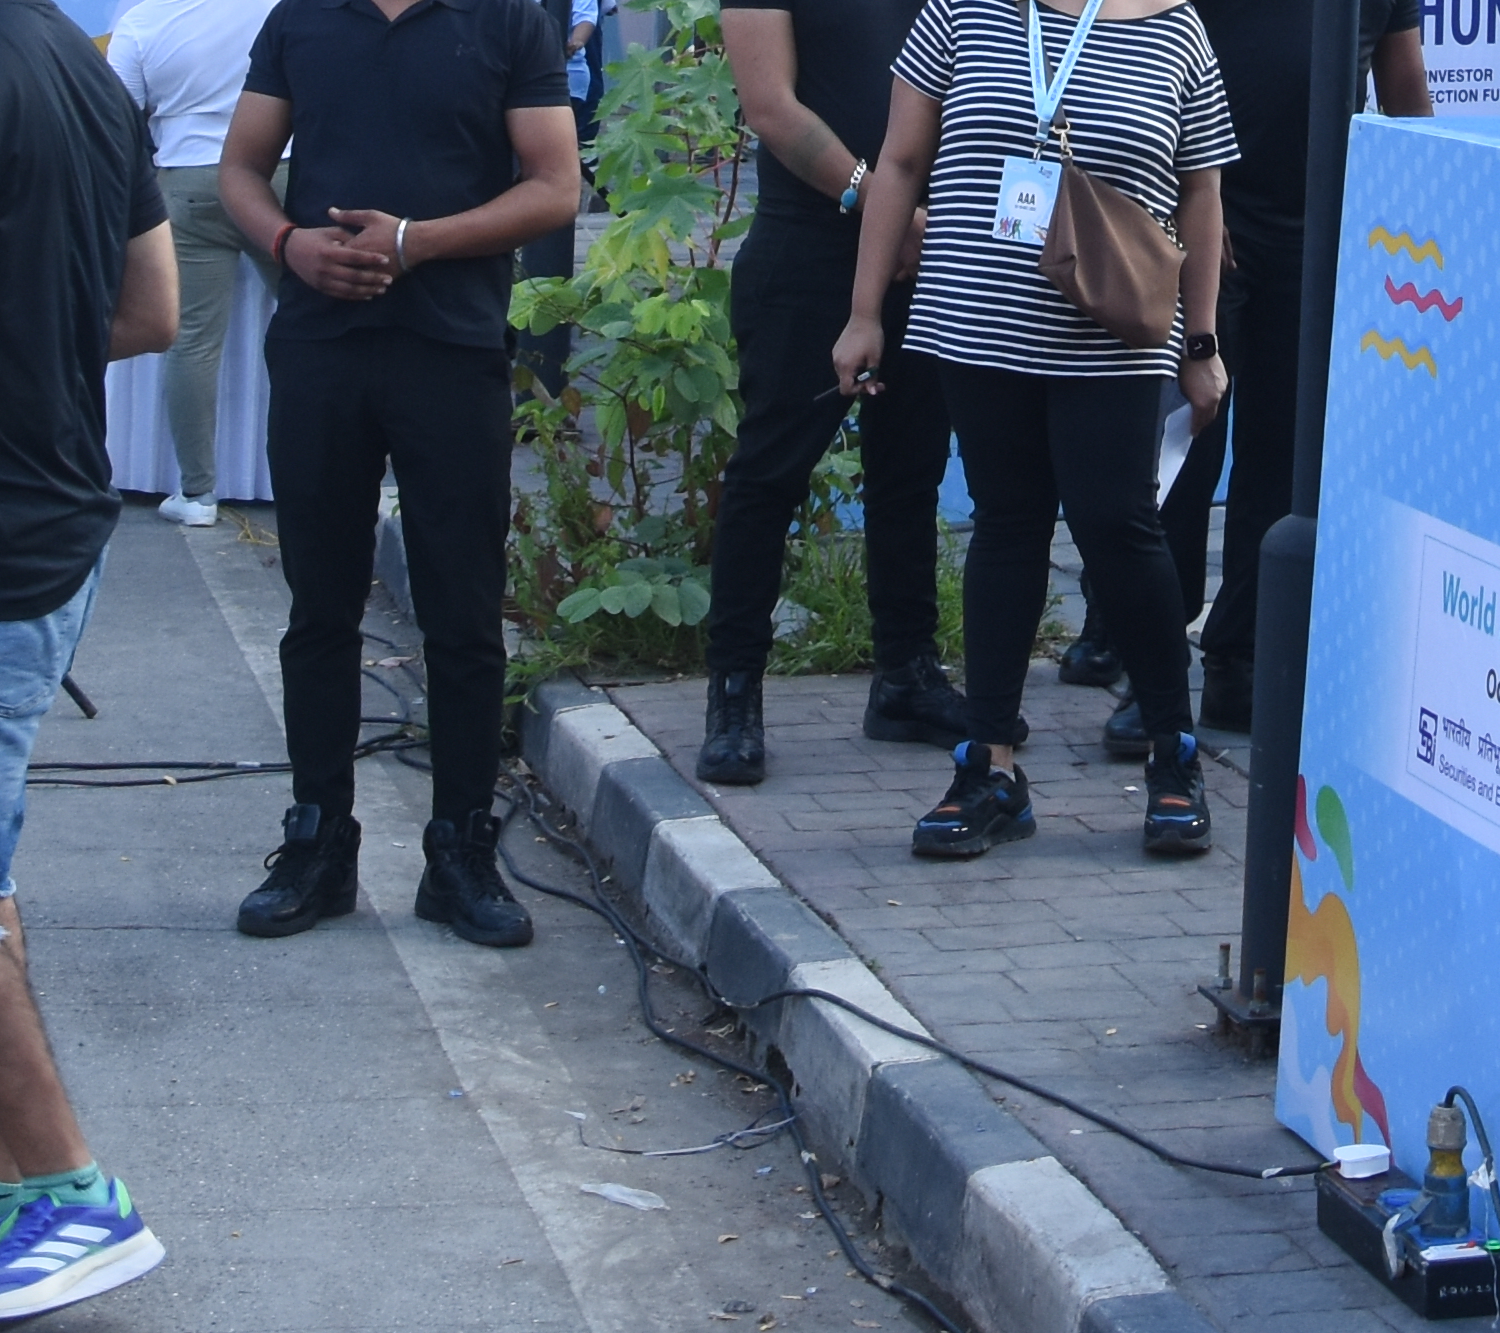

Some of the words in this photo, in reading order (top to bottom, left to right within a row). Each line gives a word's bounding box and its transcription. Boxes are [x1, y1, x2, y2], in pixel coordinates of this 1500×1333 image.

[1017, 190, 1037, 206] AAA
[1441, 569, 1497, 636] World
[1441, 715, 1473, 751] भारतीय
[1438, 753, 1478, 795] Securities
[1477, 773, 1495, 802] and
